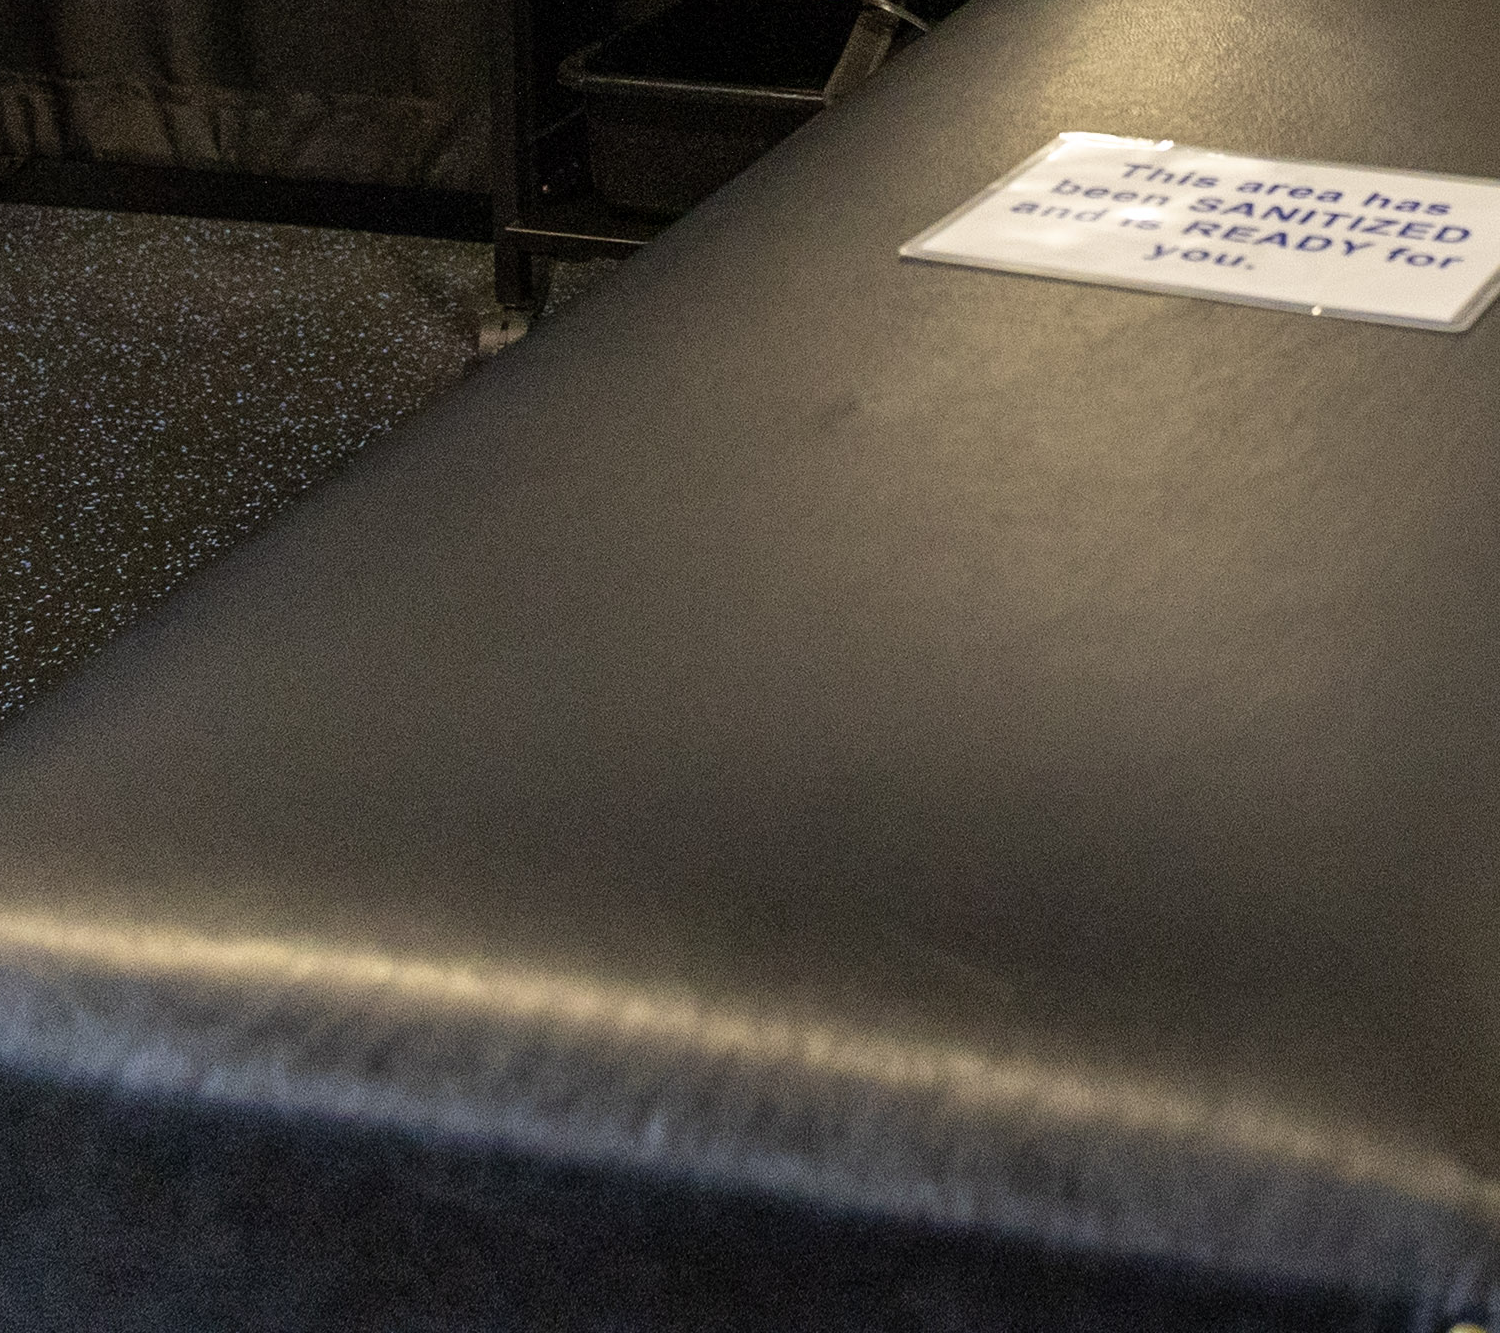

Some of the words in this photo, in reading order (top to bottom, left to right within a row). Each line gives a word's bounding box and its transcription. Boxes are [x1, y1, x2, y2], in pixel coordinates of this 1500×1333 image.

[1052, 178, 1172, 208] been
[1189, 197, 1474, 245] SANITIZED
[1121, 162, 1219, 191] This
[1237, 178, 1344, 204] area
[1361, 190, 1453, 217] has
[1009, 196, 1100, 223] and
[1183, 220, 1373, 257] READY
[1387, 245, 1465, 272] for
[1143, 241, 1257, 270] you.
